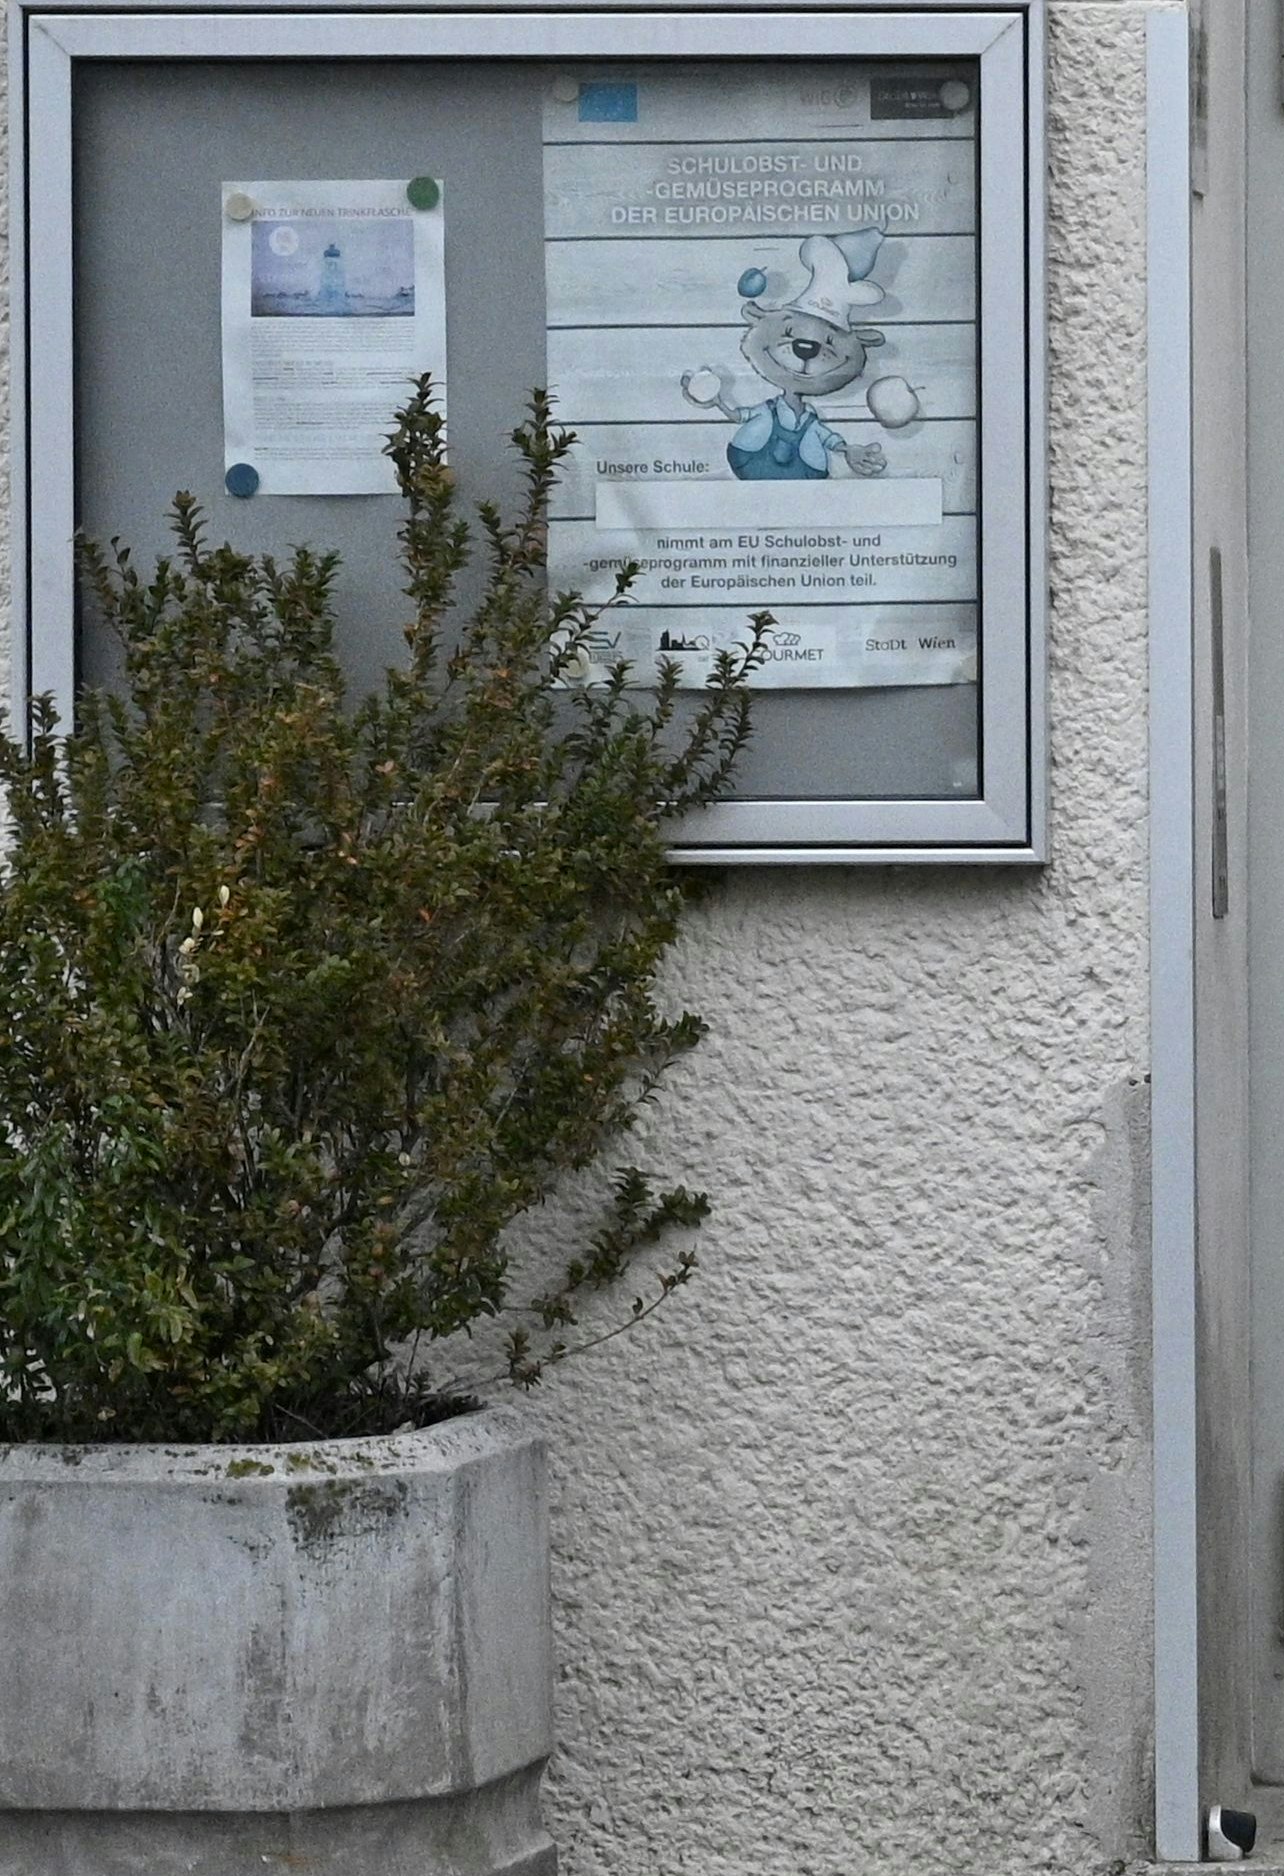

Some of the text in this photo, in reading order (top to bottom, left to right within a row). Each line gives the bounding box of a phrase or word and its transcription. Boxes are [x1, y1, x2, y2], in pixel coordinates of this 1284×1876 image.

[667, 154, 862, 175] SCHULOBST- UND
[646, 177, 885, 199] -GEMÜSEPROGRAMM
[611, 201, 919, 223] DER EUROPÄISCHEN UNION
[596, 459, 710, 475] Unsere Schule:
[657, 534, 882, 550] nimmt am EU Schulobst- und
[583, 553, 957, 573] -gemeprogramm mit finanzieller Unterstützung
[660, 573, 877, 590] der Europäischen Union teil.
[918, 636, 956, 649] Wien
[755, 648, 824, 662] OURMET
